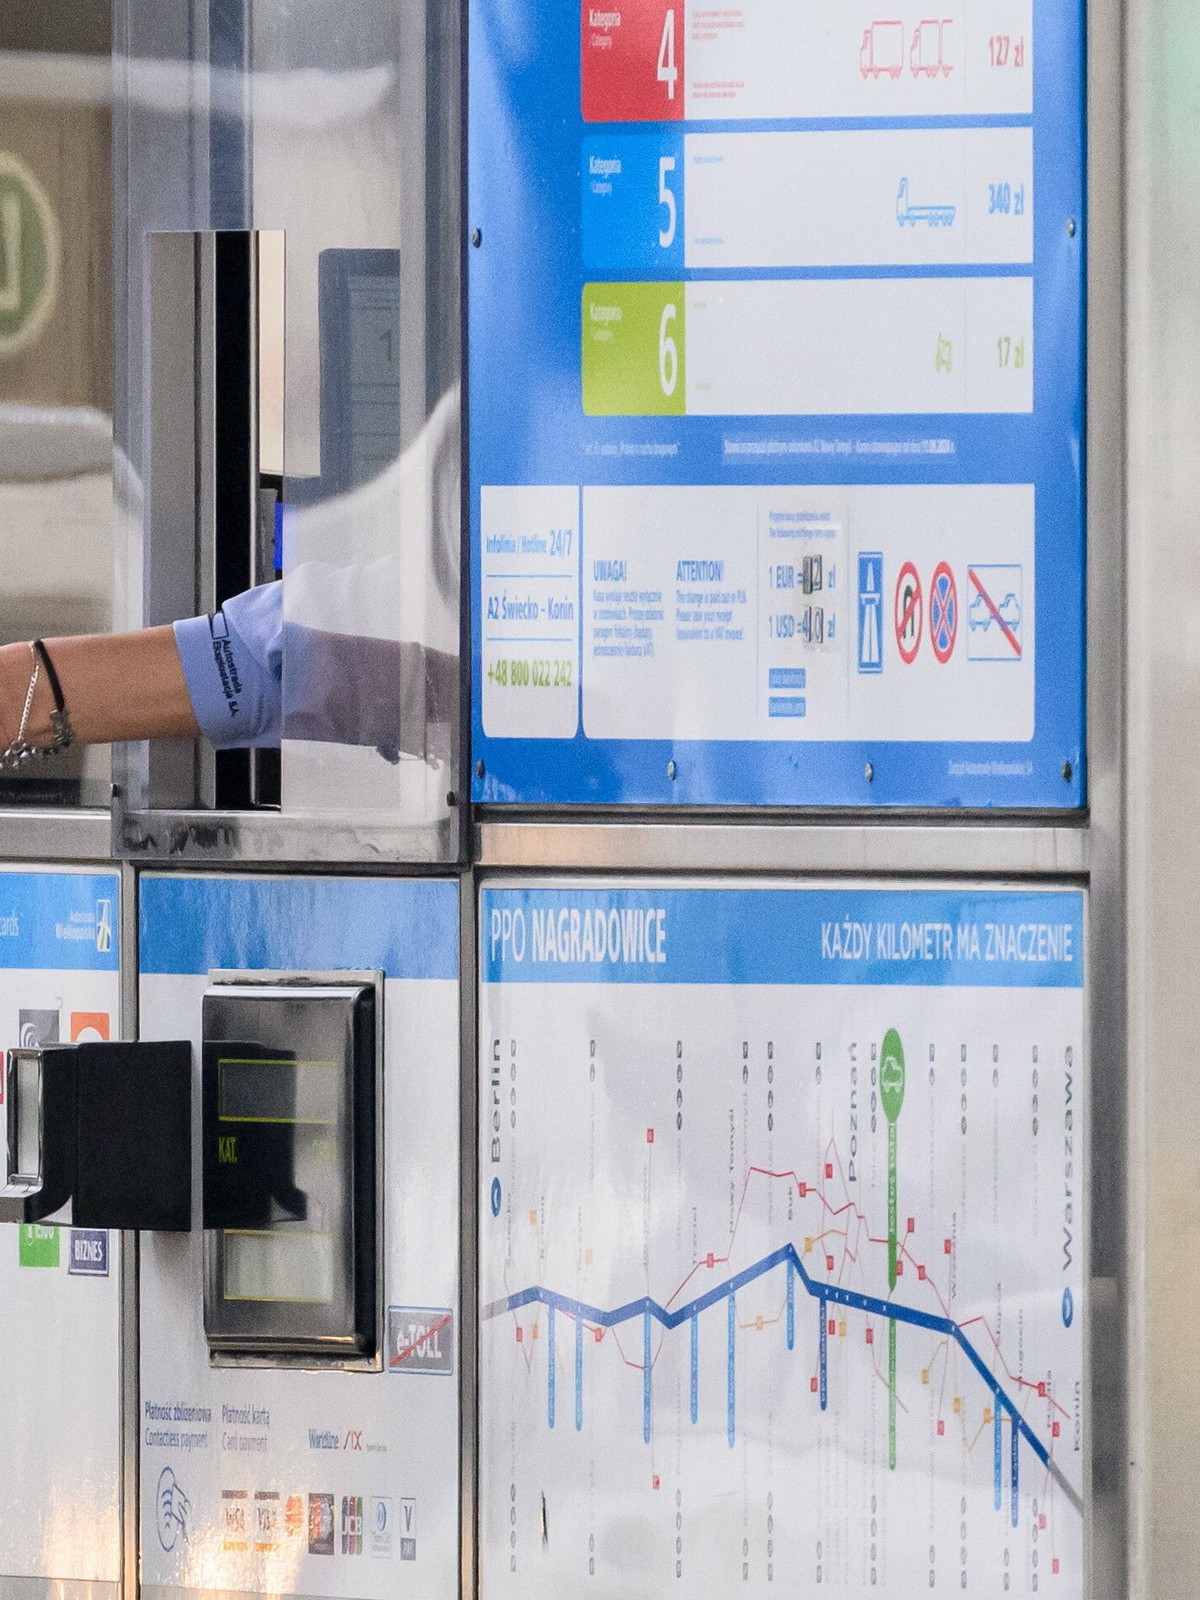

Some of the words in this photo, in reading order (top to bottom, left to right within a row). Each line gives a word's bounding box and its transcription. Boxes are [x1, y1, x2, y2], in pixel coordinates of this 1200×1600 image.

[589, 8, 621, 32] Kategoria
[657, 9, 678, 100] 4
[988, 35, 1010, 67] 127
[659, 156, 677, 248] 5
[988, 182, 1010, 214] 340
[659, 304, 678, 396] 6
[997, 336, 1011, 368] 17
[486, 533, 516, 555] Infolinia
[521, 534, 547, 555] Hotline
[550, 529, 573, 557] 24/7
[592, 560, 627, 581] UWAGA!
[675, 560, 724, 582] ATTENTION!
[776, 565, 794, 589] EUR
[487, 596, 500, 620] A2
[502, 588, 539, 620] Świecko
[548, 594, 574, 620] Konin
[776, 615, 795, 638] USD
[221, 638, 243, 695] Autostrada
[487, 660, 507, 687] +48
[511, 660, 530, 687] 800
[532, 660, 551, 687] 022
[554, 660, 573, 687] 242
[491, 908, 526, 962] PPO
[532, 908, 666, 964] NAGRADOWICE
[821, 915, 873, 960] KAŻDY
[877, 922, 953, 960] KILOMETR
[957, 924, 982, 960] MA
[985, 924, 1073, 962] ZNACZENIE
[491, 1039, 501, 1163] Berlin
[847, 1041, 857, 1182] Poznań
[1063, 1045, 1073, 1272] Warszawa
[74, 1239, 103, 1262] BIZNES
[396, 1325, 442, 1358] e-TOLL
[308, 1428, 339, 1449] Worldline
